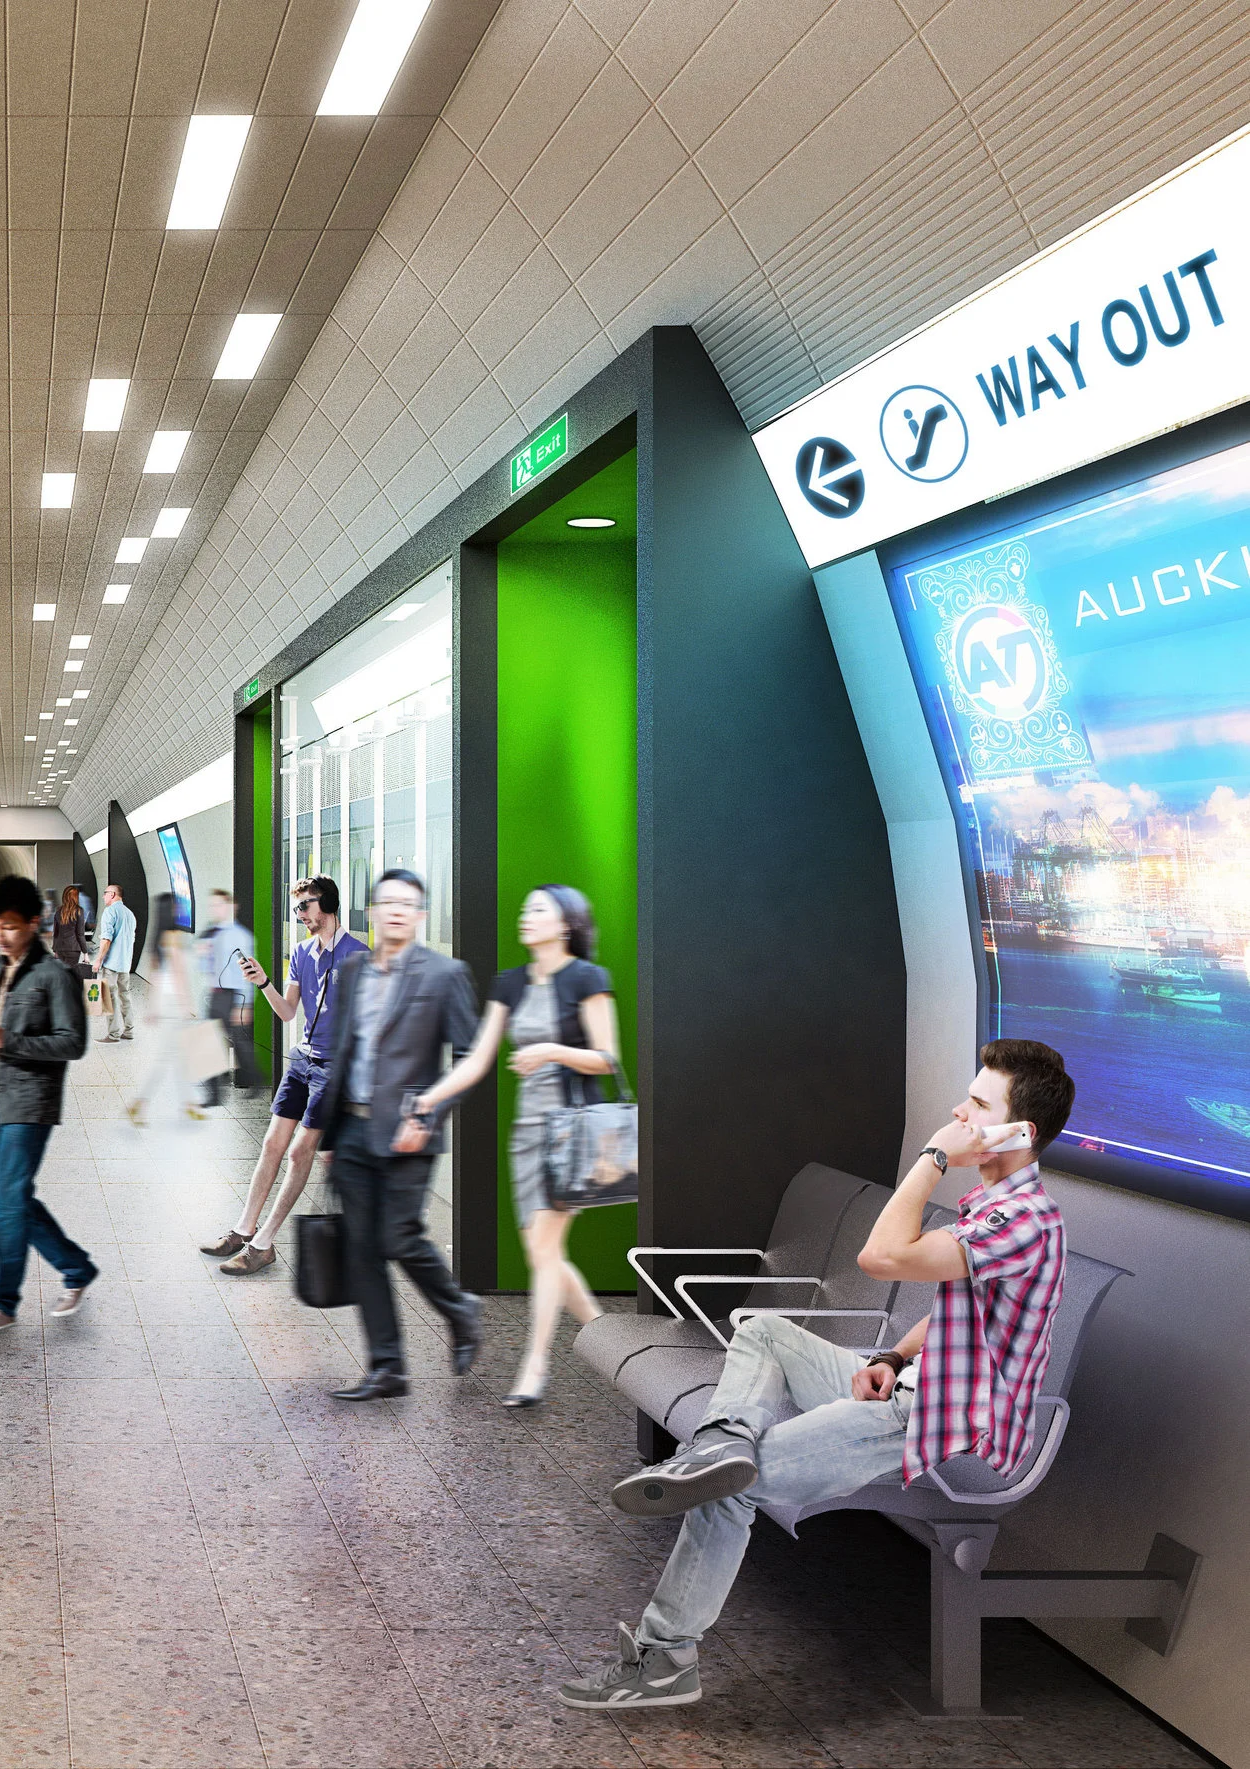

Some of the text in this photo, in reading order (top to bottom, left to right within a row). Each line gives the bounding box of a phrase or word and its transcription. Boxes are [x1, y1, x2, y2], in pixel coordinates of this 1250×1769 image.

[975, 248, 1225, 427] WAY OUT
[536, 433, 561, 464] Exit
